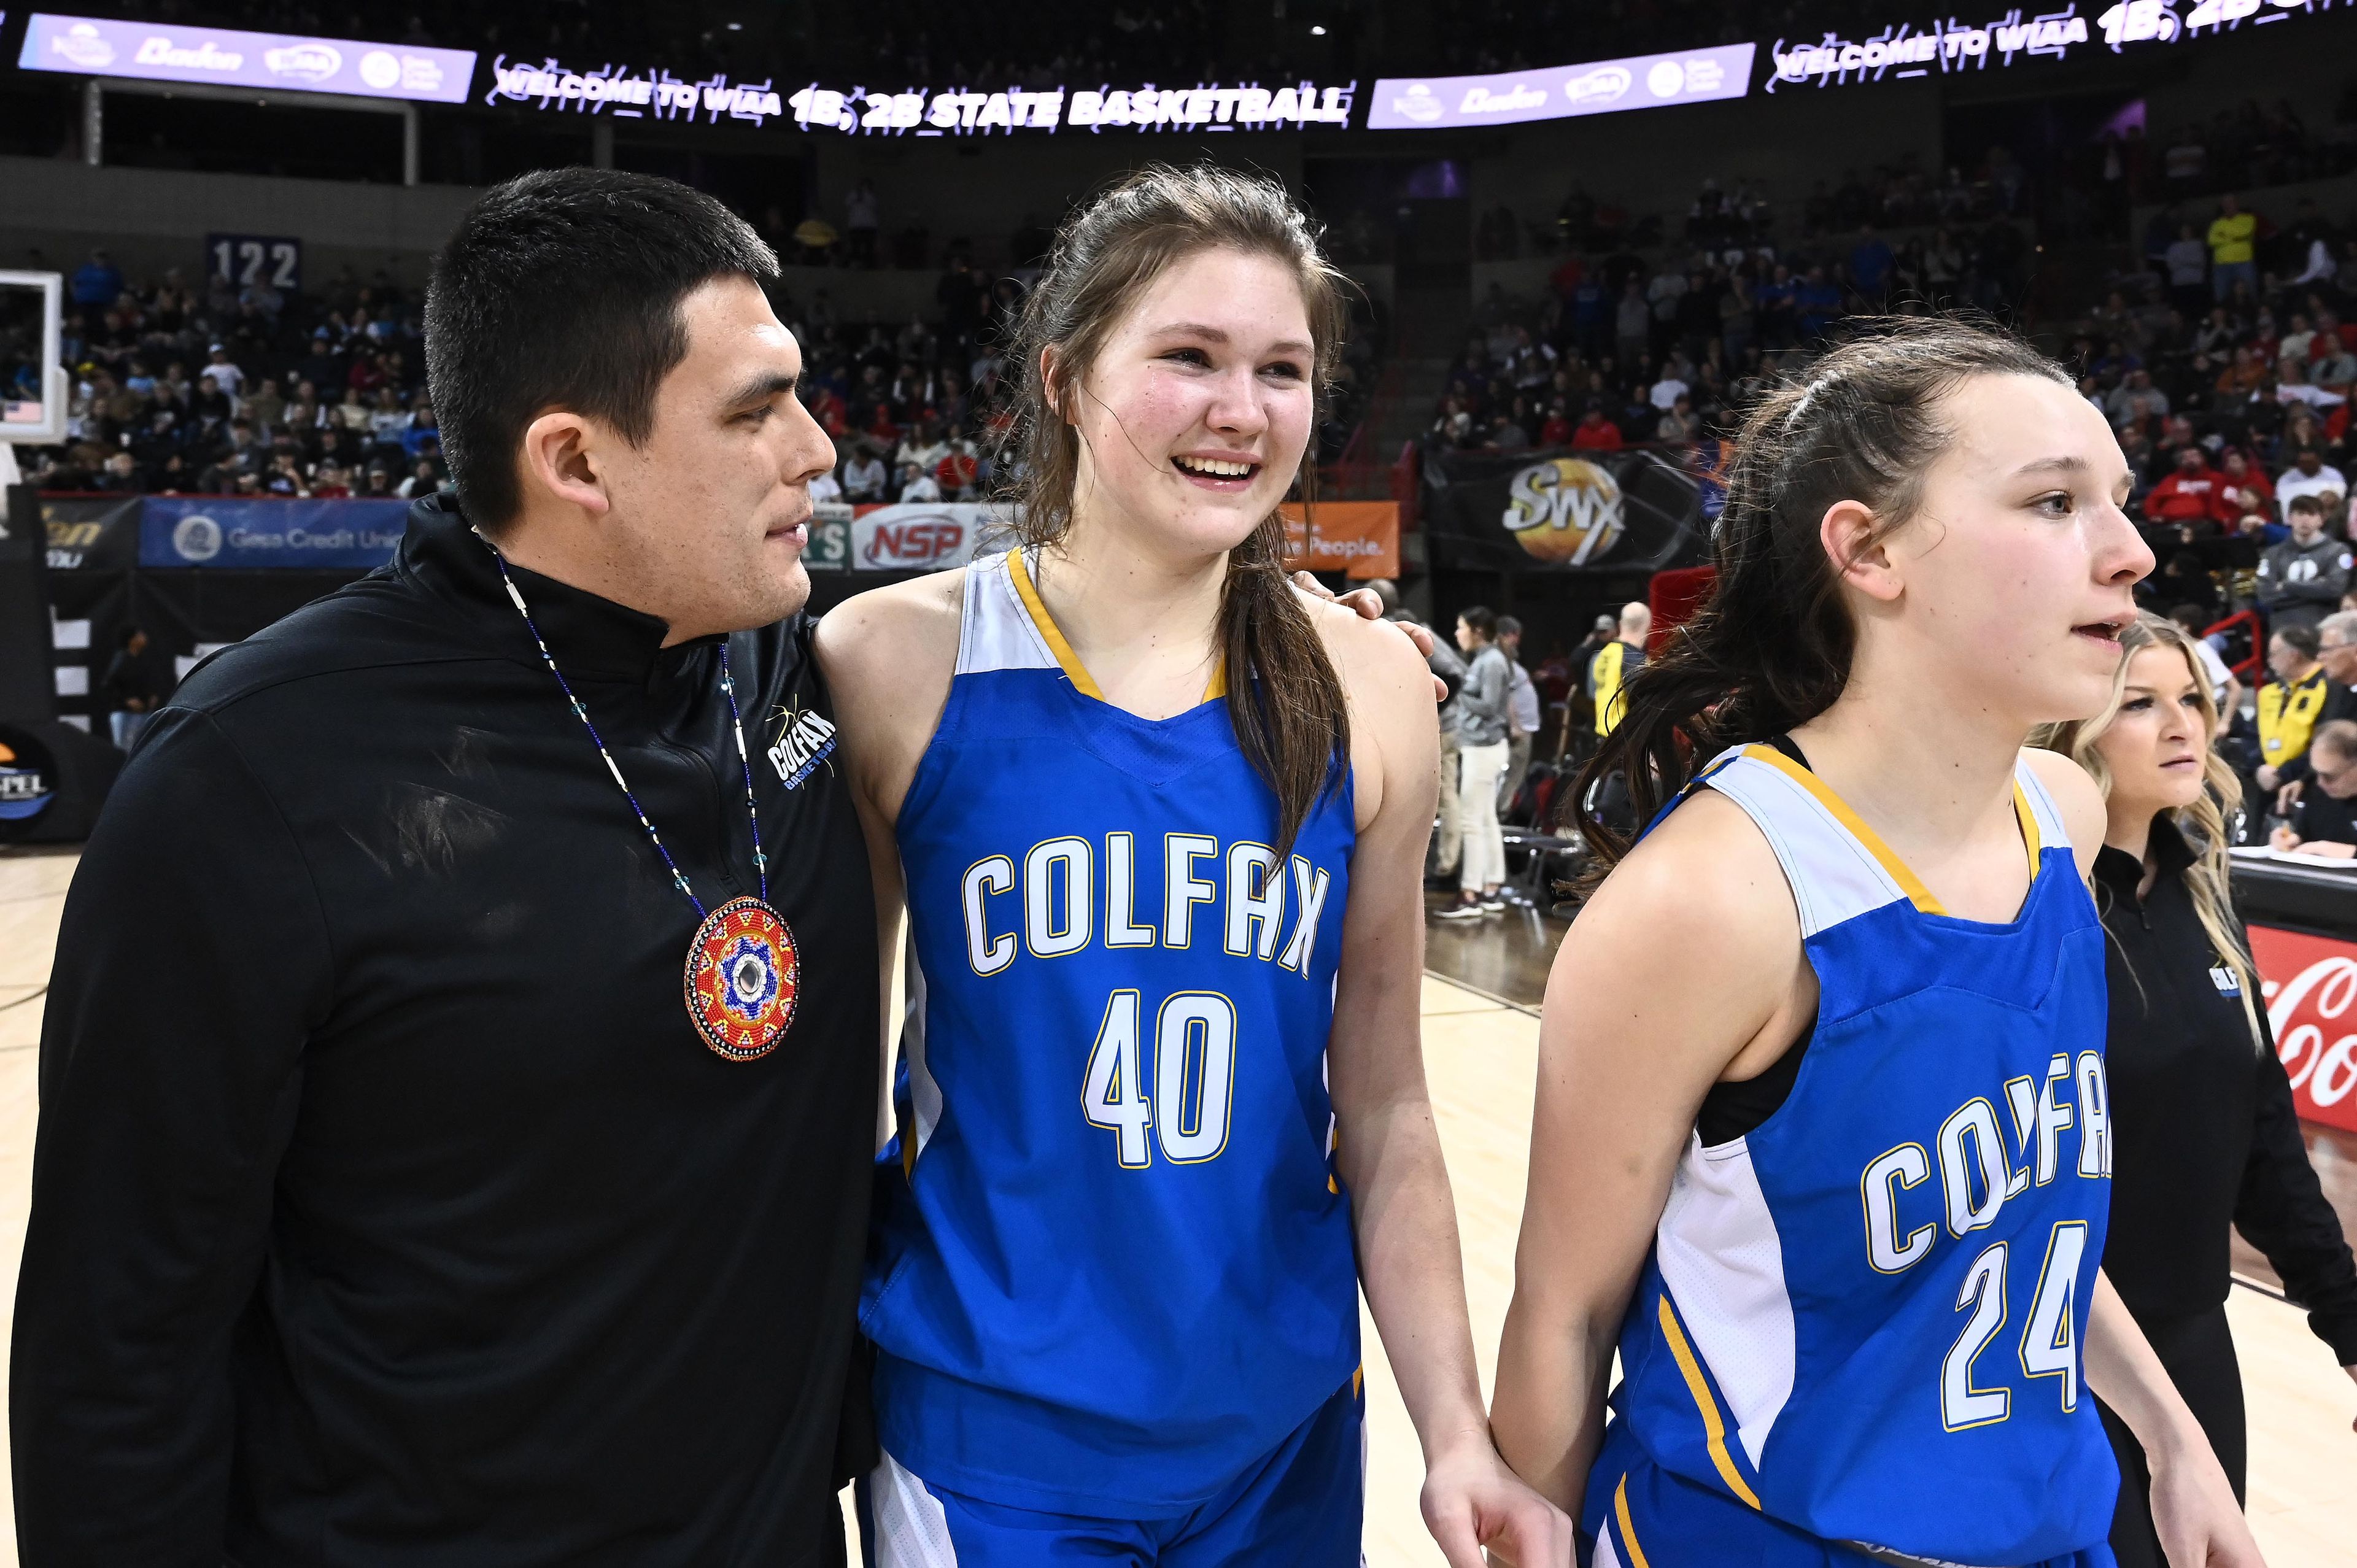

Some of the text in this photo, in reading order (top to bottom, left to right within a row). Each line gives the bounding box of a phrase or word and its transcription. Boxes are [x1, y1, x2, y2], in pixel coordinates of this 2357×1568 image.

[1778, 35, 1938, 78] WELCOME
[1945, 34, 1988, 56] TO
[1997, 17, 2088, 52] WIAA
[2097, 0, 2175, 44] 1B,
[496, 69, 1347, 131] WELCOME TO WIAA 1B, 2B STATE BASKETBALL
[214, 241, 297, 288] 122
[287, 527, 354, 549] Credit
[872, 525, 964, 558] NSP
[767, 710, 836, 781] COLFAX
[961, 831, 1330, 980] COLFAX
[1080, 988, 1237, 1169] 40
[1860, 1049, 2112, 1275] COLFA
[1940, 1219, 2089, 1433] 24
